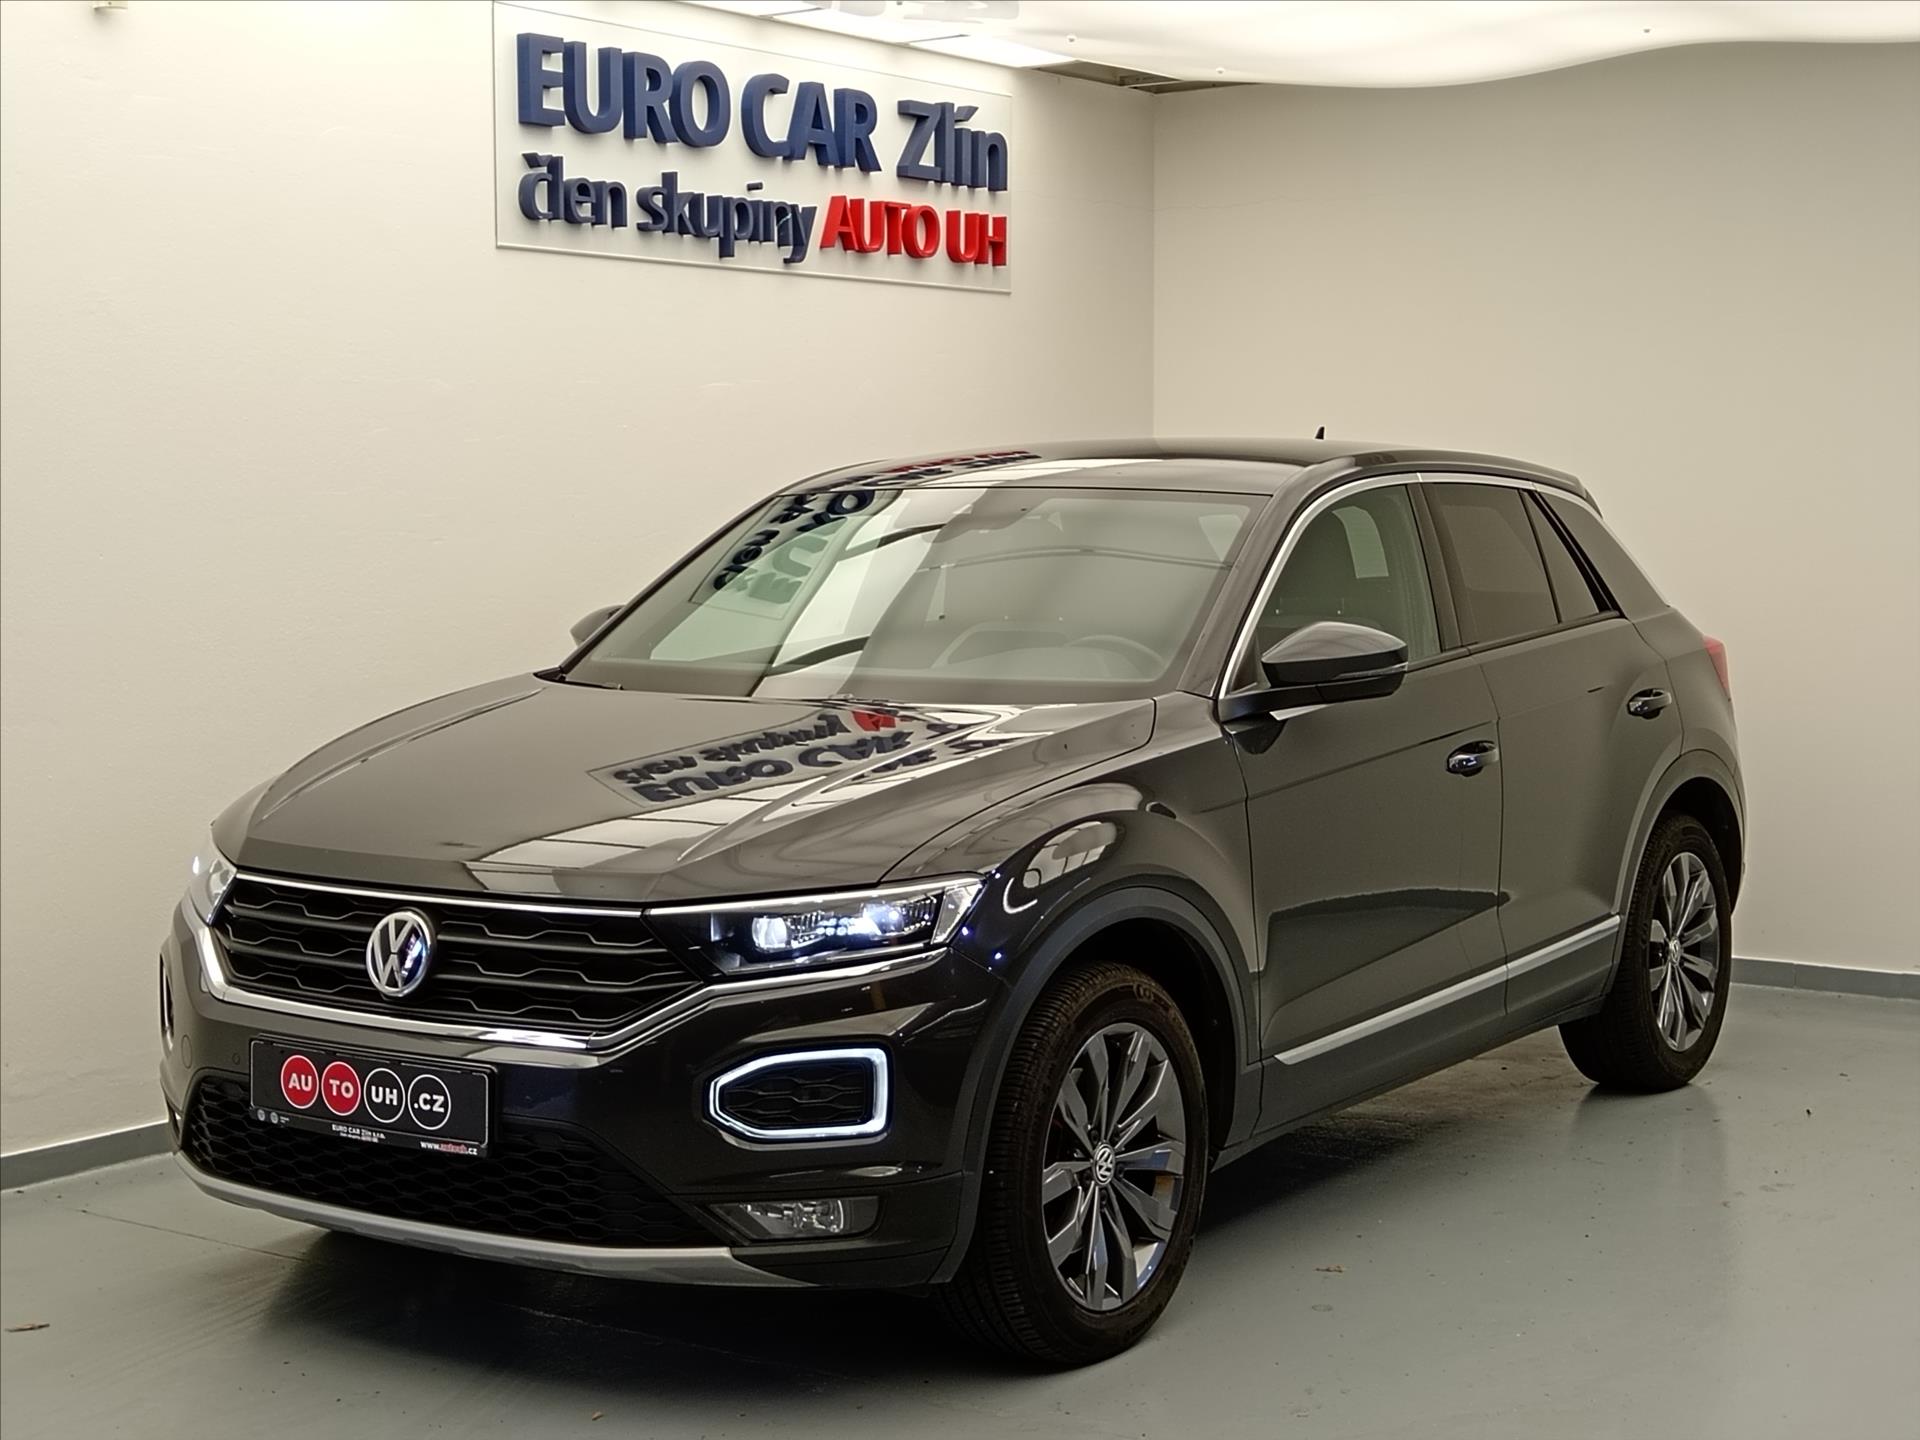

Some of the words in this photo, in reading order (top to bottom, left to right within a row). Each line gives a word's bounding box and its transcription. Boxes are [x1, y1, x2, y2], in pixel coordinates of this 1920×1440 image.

[516, 32, 731, 148] EURO
[741, 73, 882, 173] CAR
[896, 99, 1008, 192] Zlín
[518, 152, 628, 228] člen
[635, 171, 817, 264] skupiny
[819, 195, 940, 259] AUTO
[946, 209, 1008, 266] UH
[288, 1072, 313, 1092] AU
[329, 1078, 355, 1099] TO
[370, 1085, 399, 1106] UH
[413, 1092, 446, 1113] .CZ
